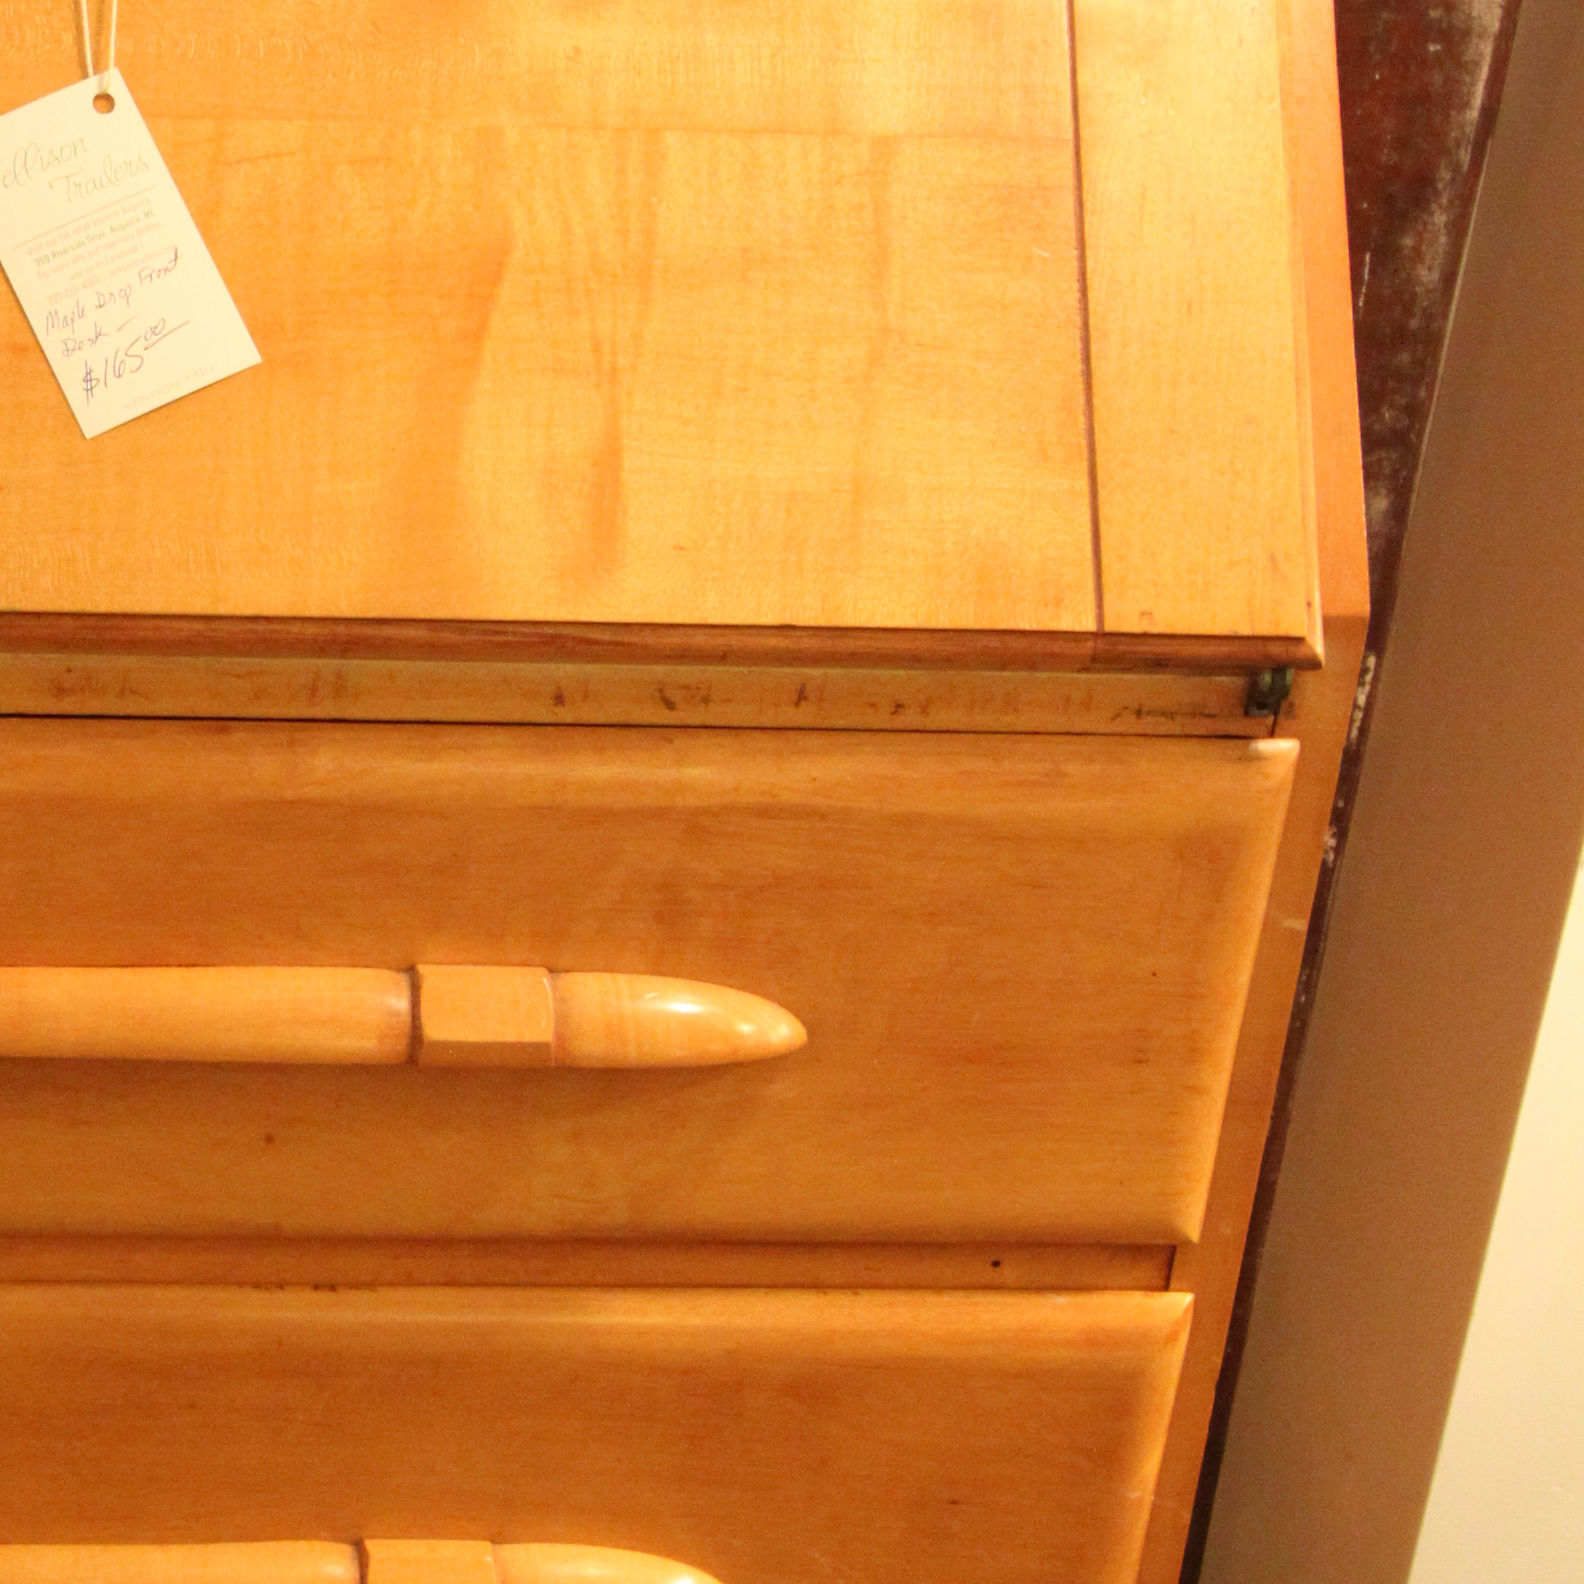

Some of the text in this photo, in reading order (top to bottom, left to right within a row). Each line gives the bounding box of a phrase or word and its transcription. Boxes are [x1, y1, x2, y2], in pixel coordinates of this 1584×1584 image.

[47, 154, 150, 204] Traders
[95, 283, 133, 309] Drop
[137, 247, 181, 286] Front
[61, 321, 111, 358] Desk
